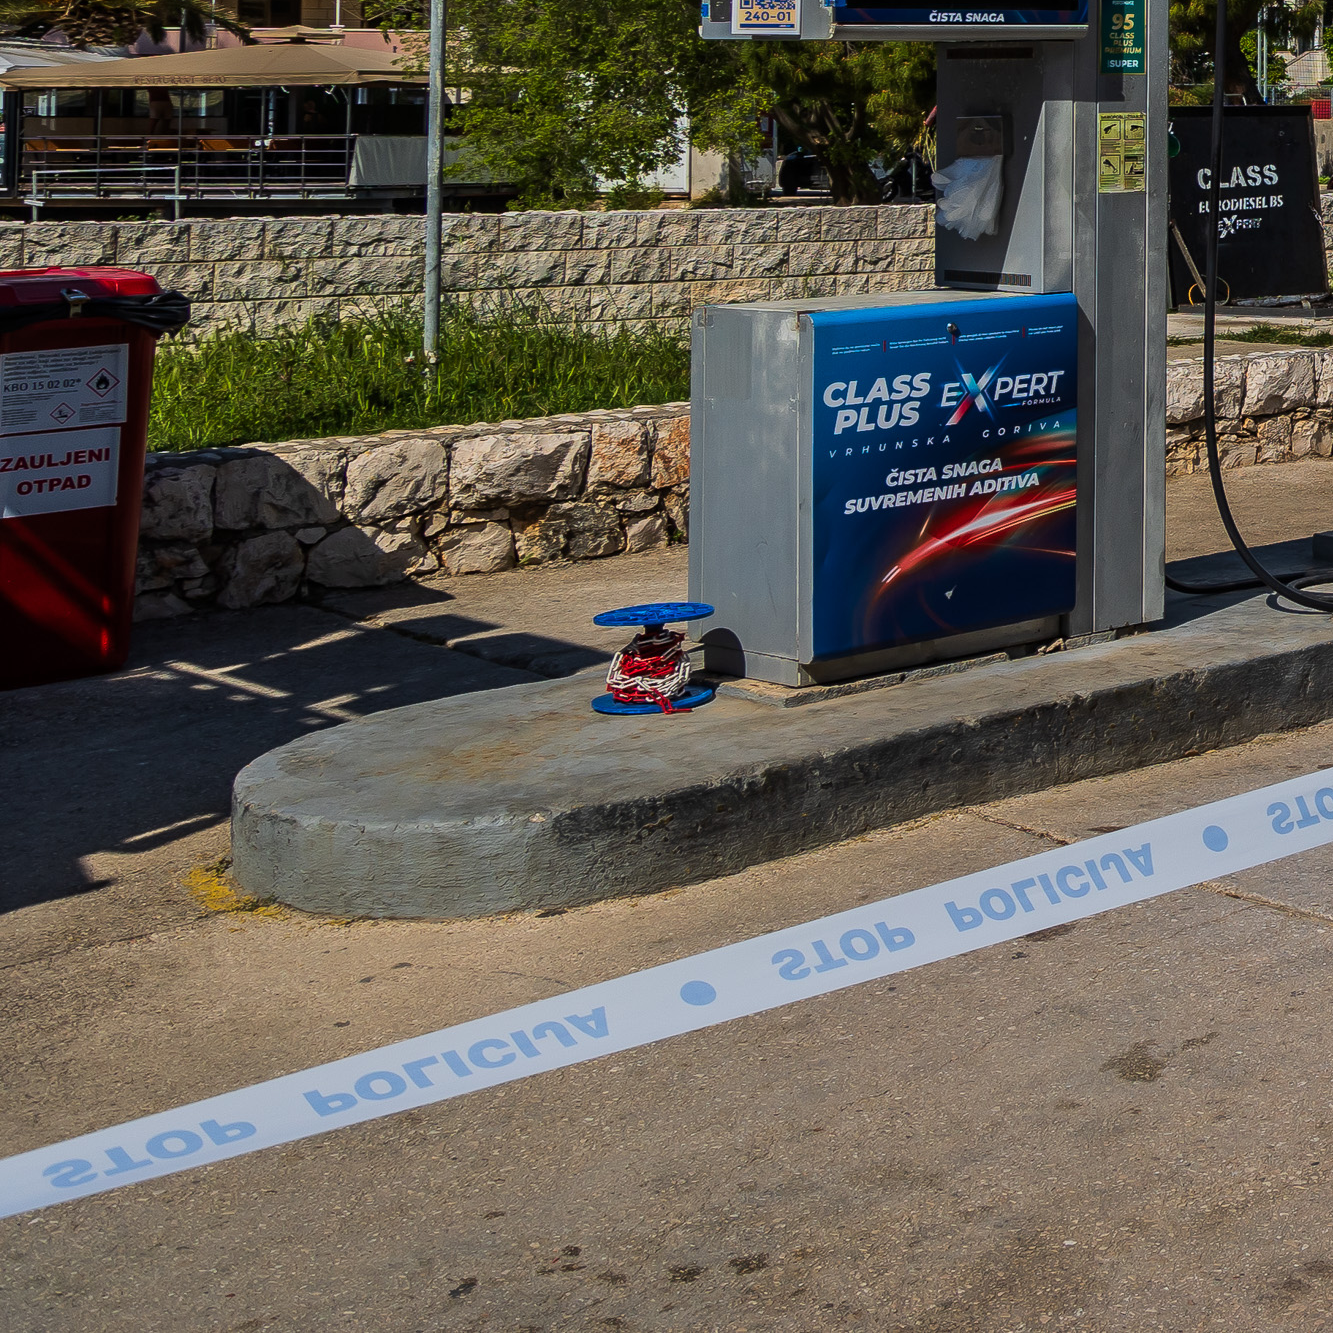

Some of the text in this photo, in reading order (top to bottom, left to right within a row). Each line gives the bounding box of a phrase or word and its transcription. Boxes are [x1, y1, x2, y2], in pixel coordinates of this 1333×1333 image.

[744, 11, 791, 22] 240-01
[929, 10, 1005, 22] ČISTA SNAGA
[1111, 13, 1135, 30] 95
[4, 382, 28, 392] KBO
[32, 380, 45, 390] 15
[47, 380, 60, 389] 02
[823, 372, 932, 407] CLASS
[1022, 396, 1061, 406] FORMULA
[834, 401, 921, 435] PLUS
[829, 420, 1061, 458] VRHUNSKA GORIVA
[0, 447, 110, 472] ZAULJENI
[886, 458, 1003, 487] ČISTA SNAGA
[16, 474, 91, 495] OTPAD
[844, 472, 1040, 514] SUVREMENIH ADITIVA
